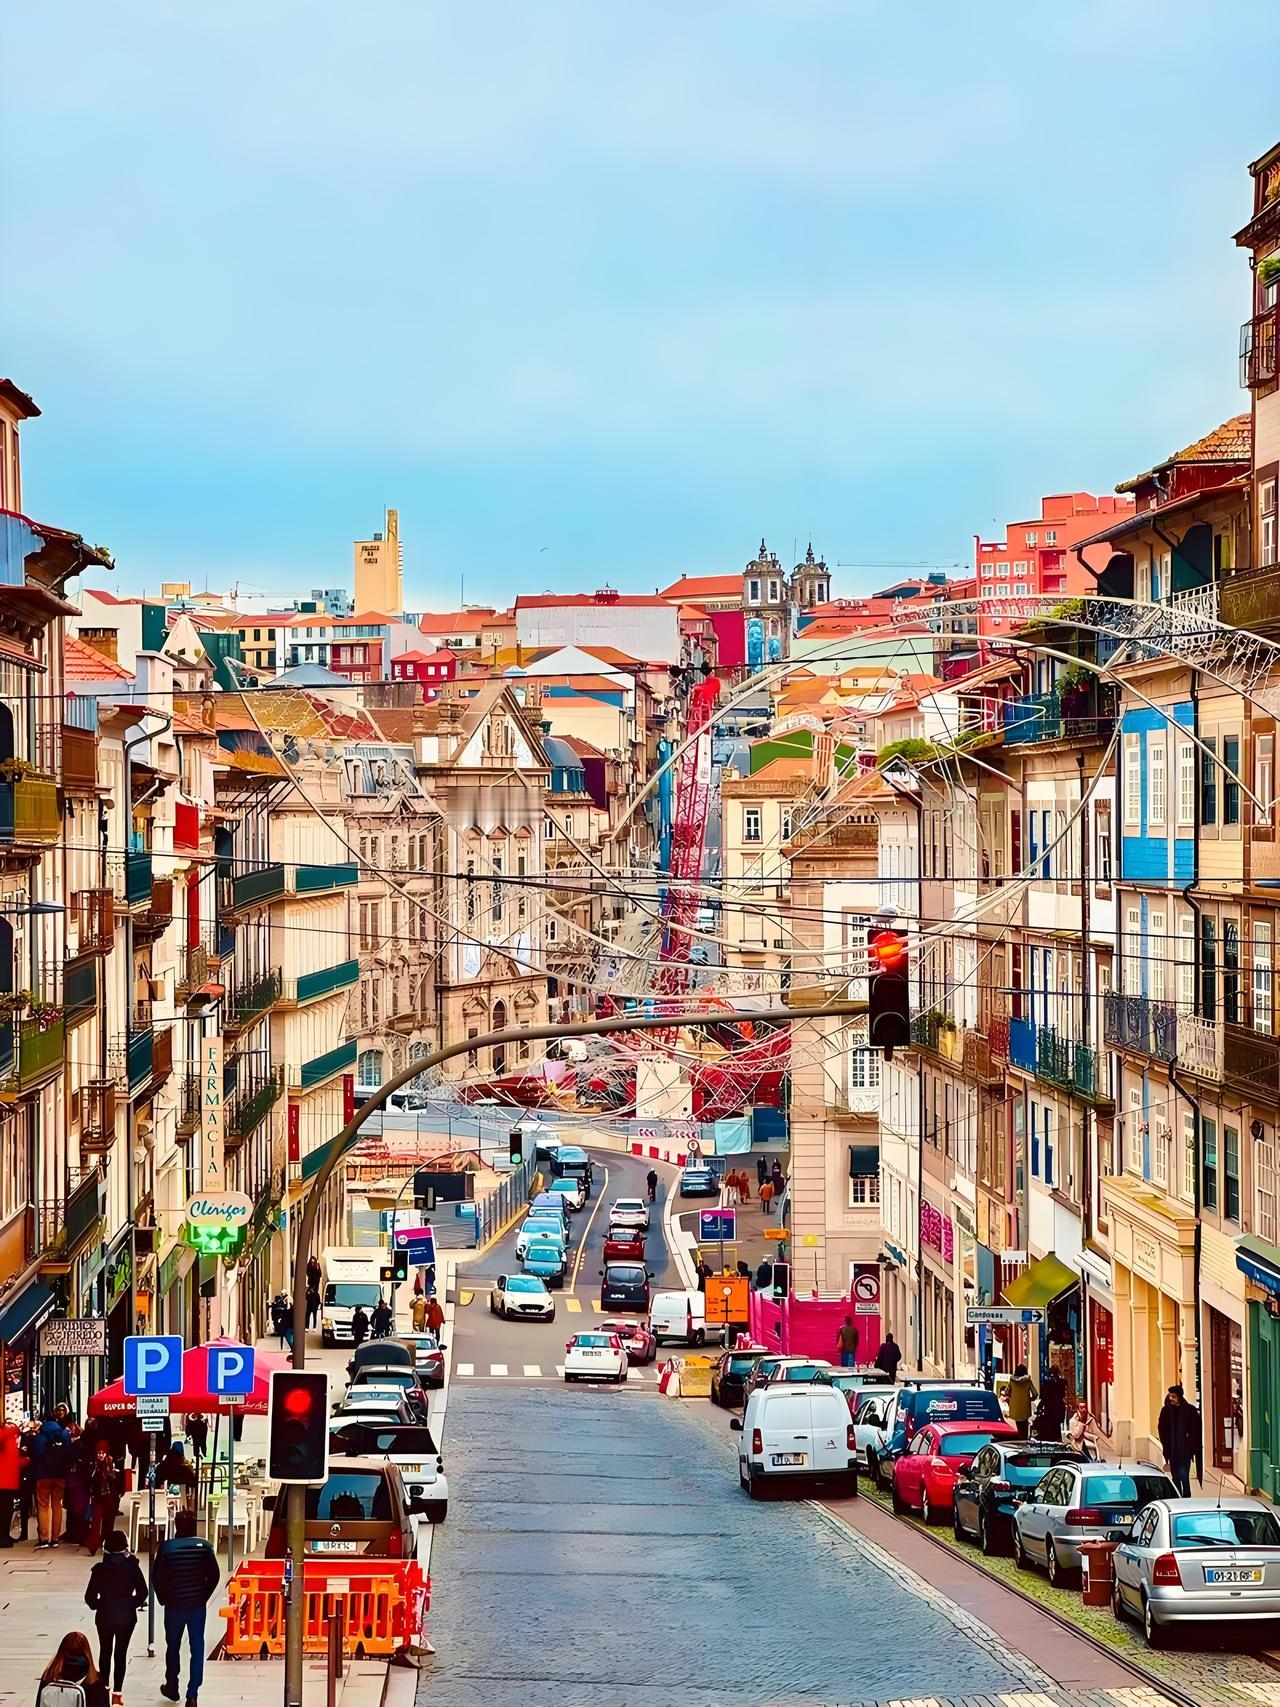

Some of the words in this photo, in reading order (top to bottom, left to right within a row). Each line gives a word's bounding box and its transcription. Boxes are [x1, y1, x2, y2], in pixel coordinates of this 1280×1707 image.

[205, 1047, 220, 1174] FARMÁCIA
[137, 1342, 170, 1389] P
[217, 1351, 244, 1390] P
